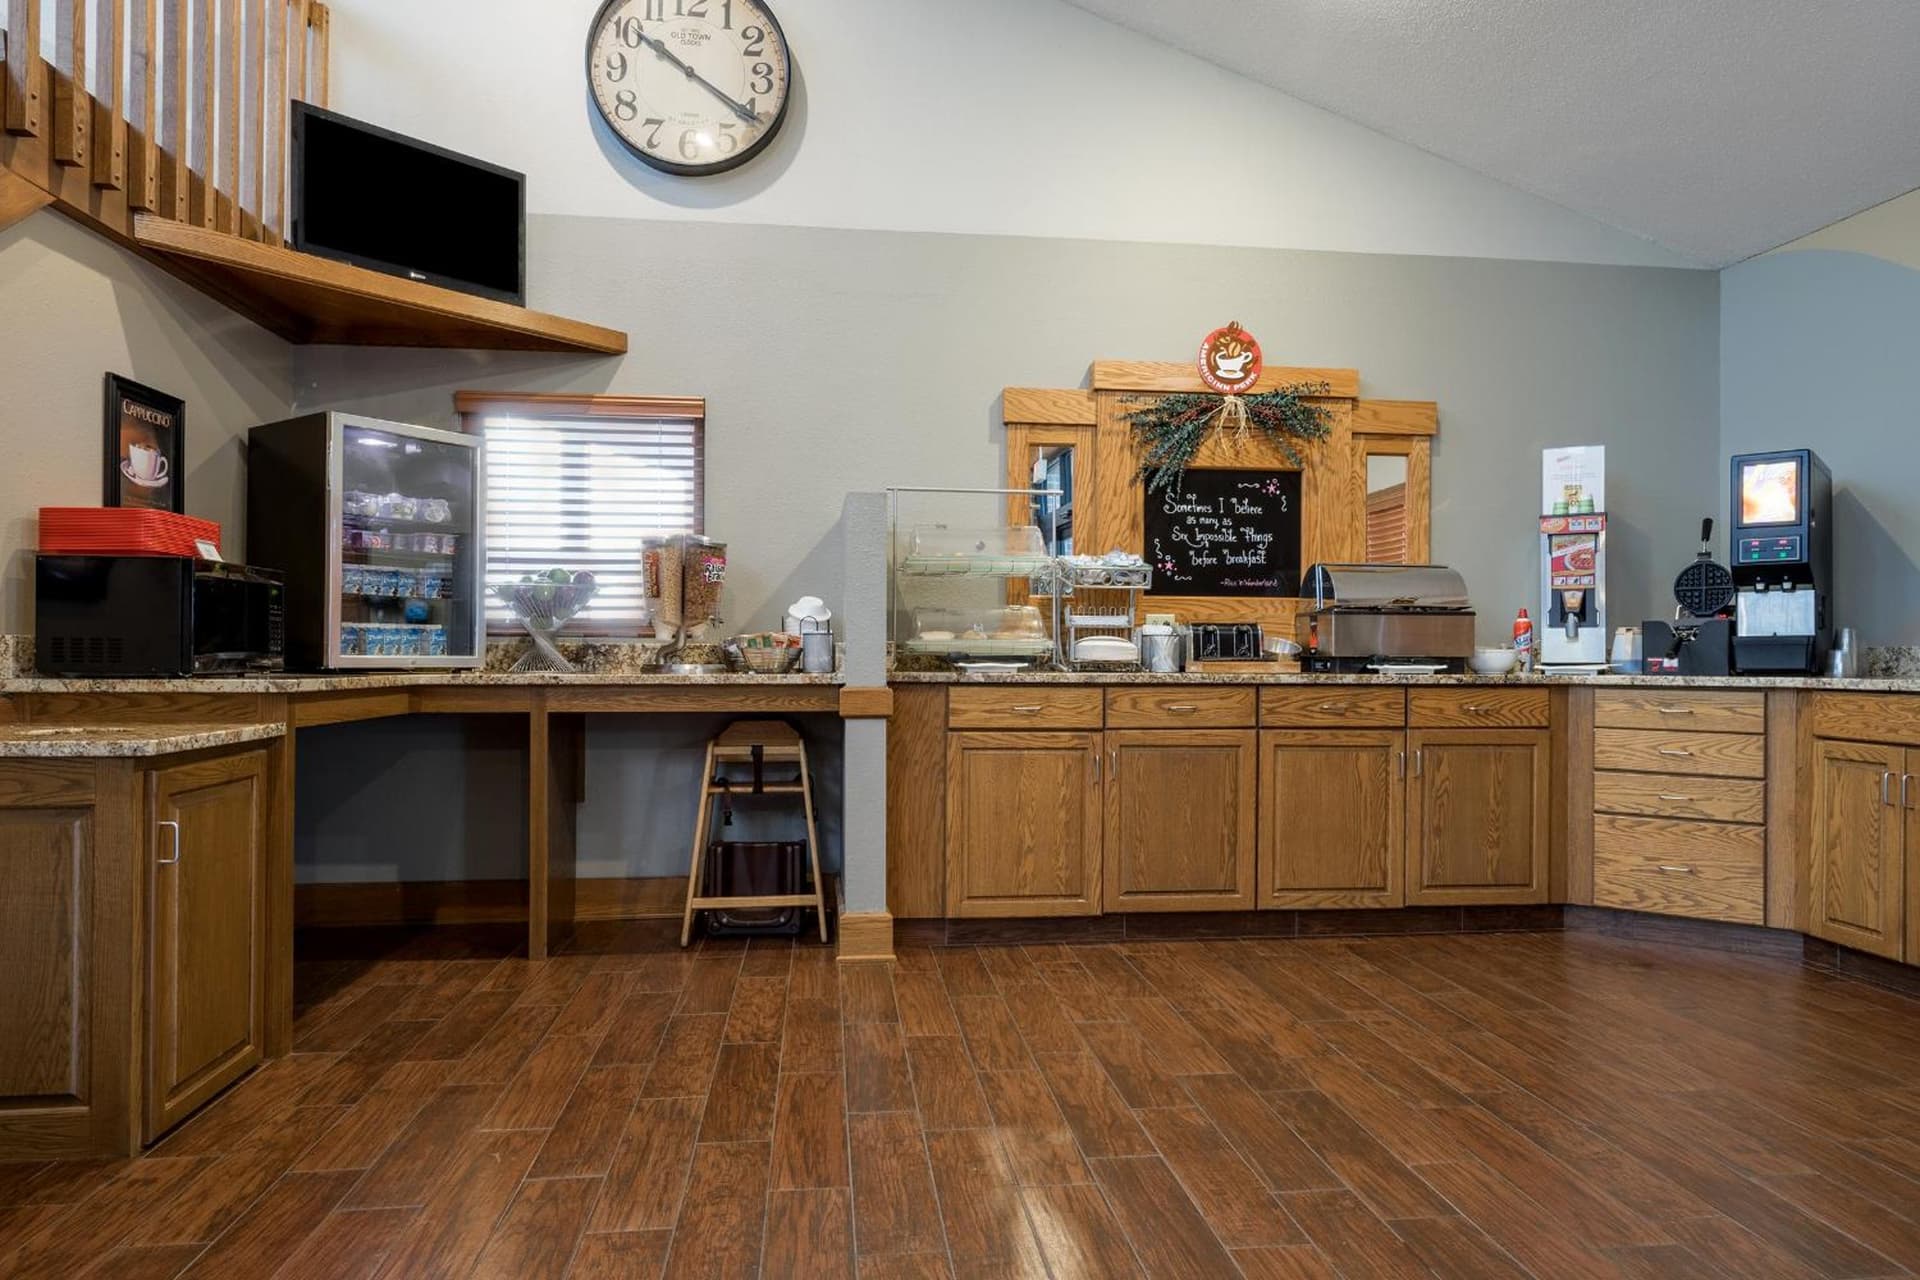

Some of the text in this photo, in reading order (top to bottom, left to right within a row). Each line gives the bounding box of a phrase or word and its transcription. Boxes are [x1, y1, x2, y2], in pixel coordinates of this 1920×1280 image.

[674, 0, 708, 18] 12
[721, 0, 733, 30] 1
[614, 16, 643, 49] 10
[671, 31, 711, 41] OLD TOWN
[741, 26, 765, 57] 2
[606, 52, 628, 82] 9
[750, 62, 774, 94] 3
[614, 90, 638, 121] 8
[642, 117, 665, 149] 7
[678, 128, 700, 160] 6
[718, 122, 738, 154] 5
[123, 398, 171, 428] CAPPUCCINO
[1163, 492, 1263, 514] Sometimes I believe
[1186, 515, 1233, 529] as many as
[1189, 549, 1267, 568] before breakfast
